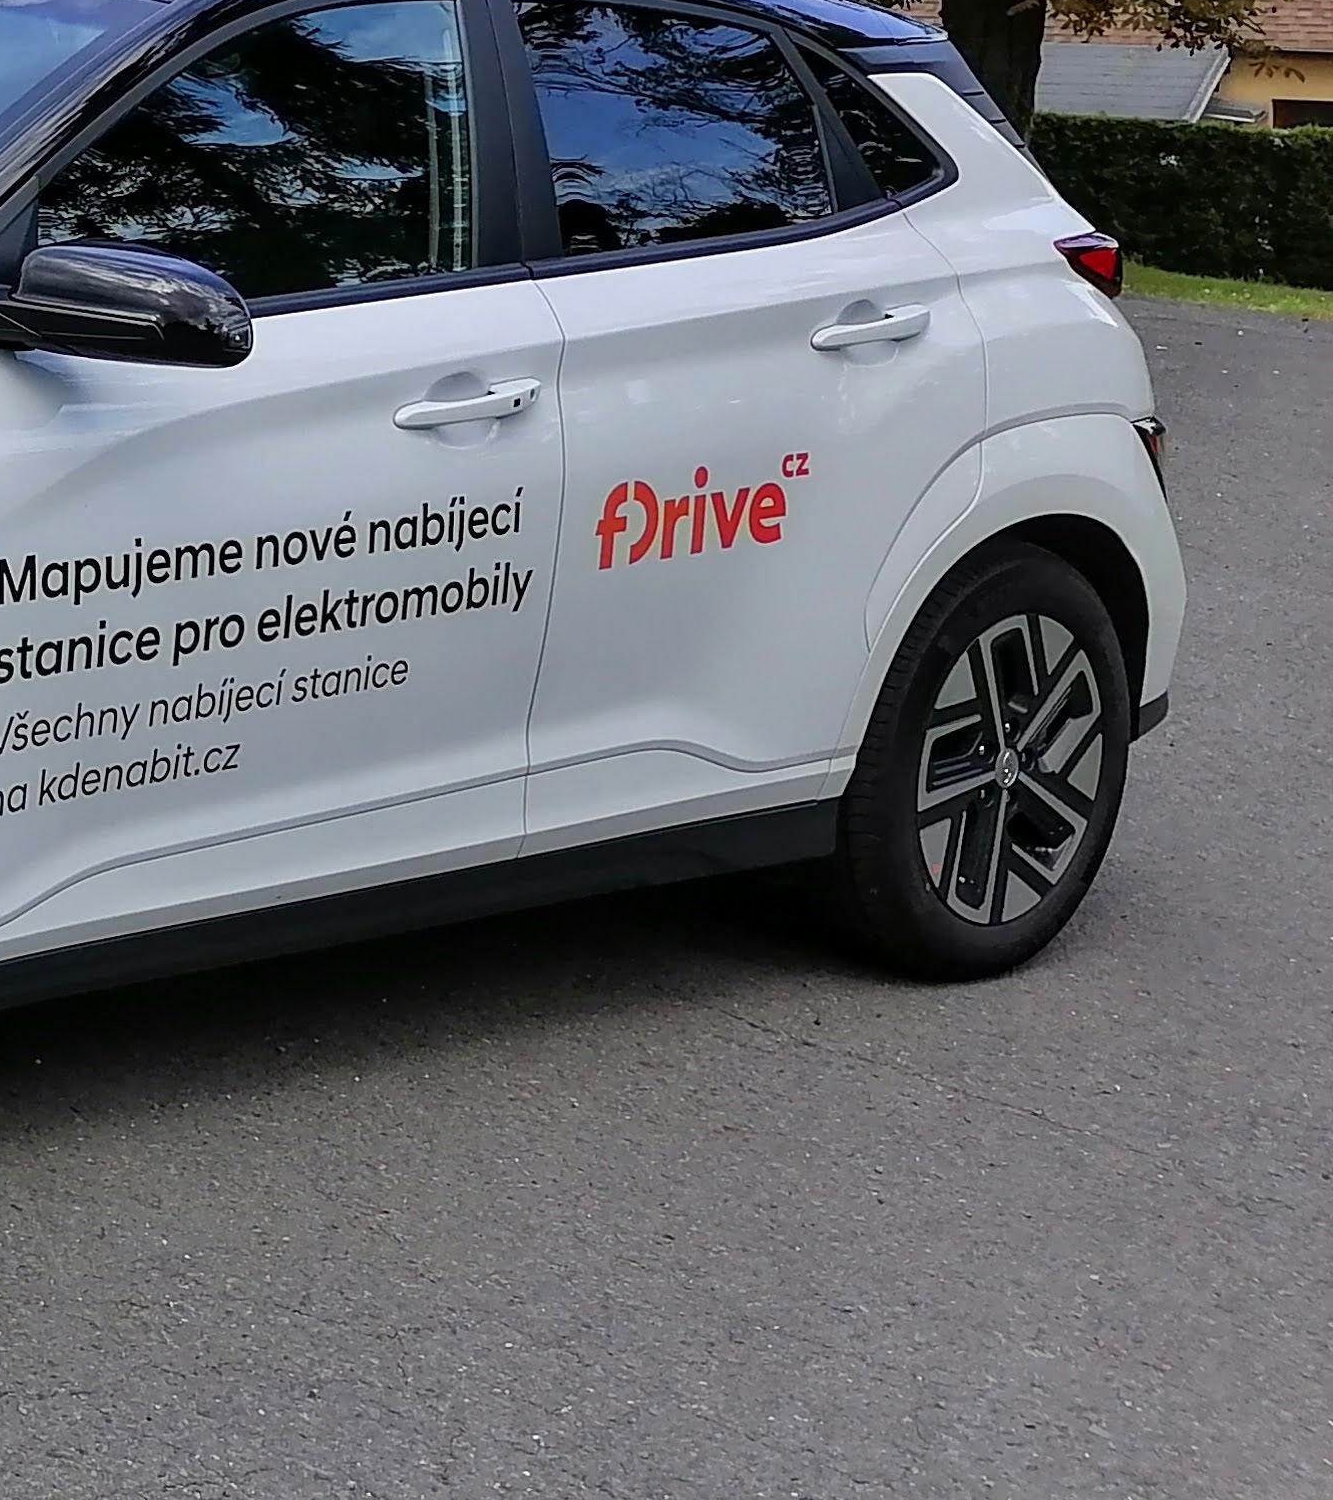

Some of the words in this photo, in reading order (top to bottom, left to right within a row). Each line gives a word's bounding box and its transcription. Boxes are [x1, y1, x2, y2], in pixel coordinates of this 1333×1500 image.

[255, 510, 357, 570] nové
[368, 486, 524, 553] nabíjecí
[172, 613, 245, 666] pro
[257, 561, 533, 643] elektromobily
[148, 668, 287, 727] nabíjecí
[291, 654, 410, 703] stanice
[37, 742, 242, 807] kdenabit.cz
